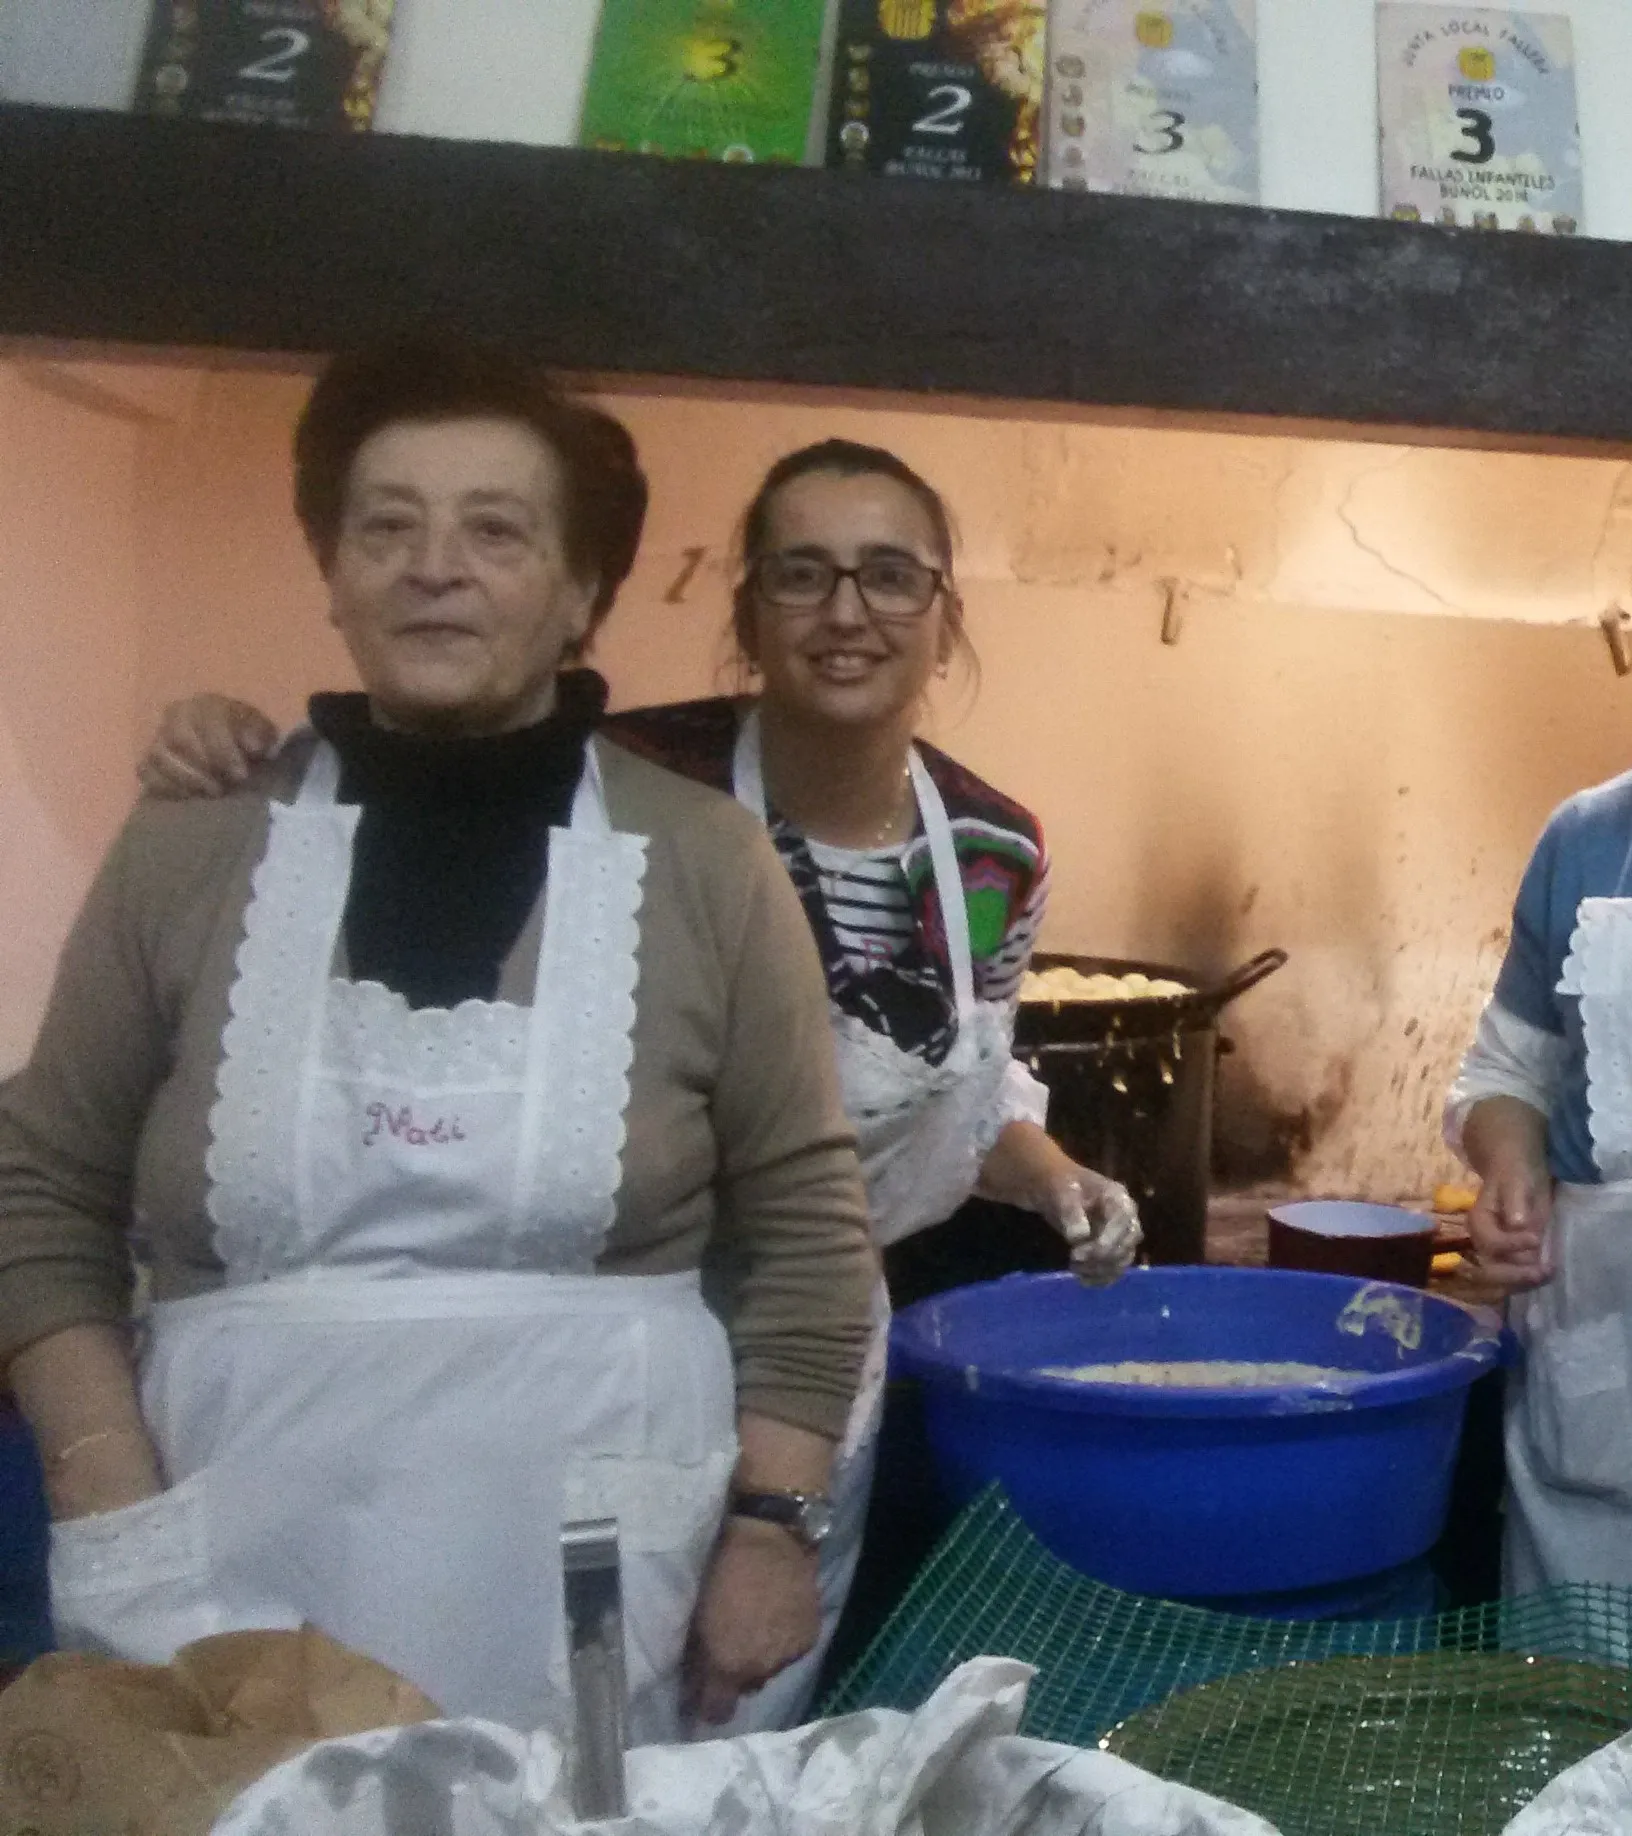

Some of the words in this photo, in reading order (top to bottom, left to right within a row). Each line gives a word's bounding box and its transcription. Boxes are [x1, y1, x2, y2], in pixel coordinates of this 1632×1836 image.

[1440, 20, 1490, 37] LOCAL
[238, 27, 310, 82] 2
[683, 38, 743, 82] 3
[911, 84, 972, 135] 2
[1448, 84, 1506, 101] PREMIO
[1132, 110, 1186, 155] 3
[1450, 107, 1496, 164] 3
